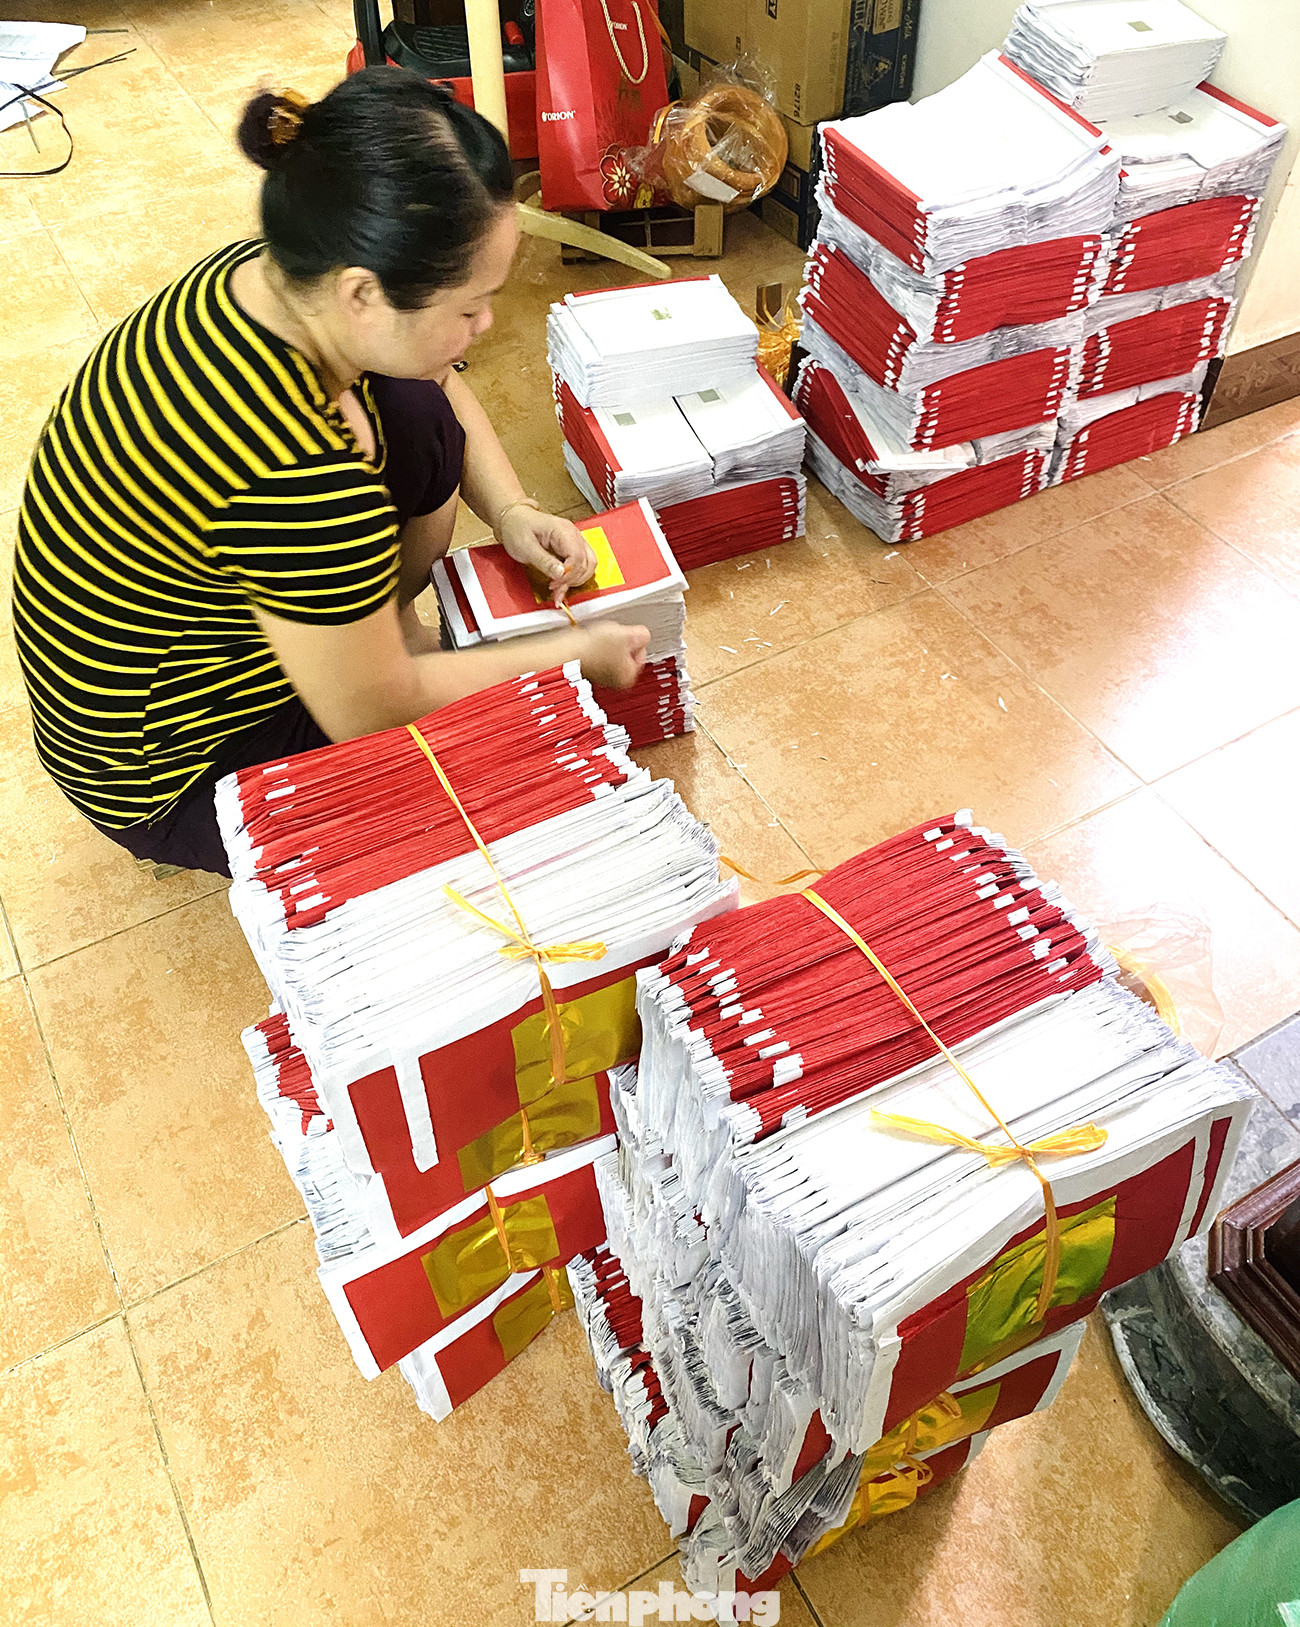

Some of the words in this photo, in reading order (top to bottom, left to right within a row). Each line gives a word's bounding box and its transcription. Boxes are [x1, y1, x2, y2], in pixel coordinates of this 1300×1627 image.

[899, 54, 907, 89] EXPORT
[546, 110, 575, 122] ORION
[793, 83, 801, 118] 82176
